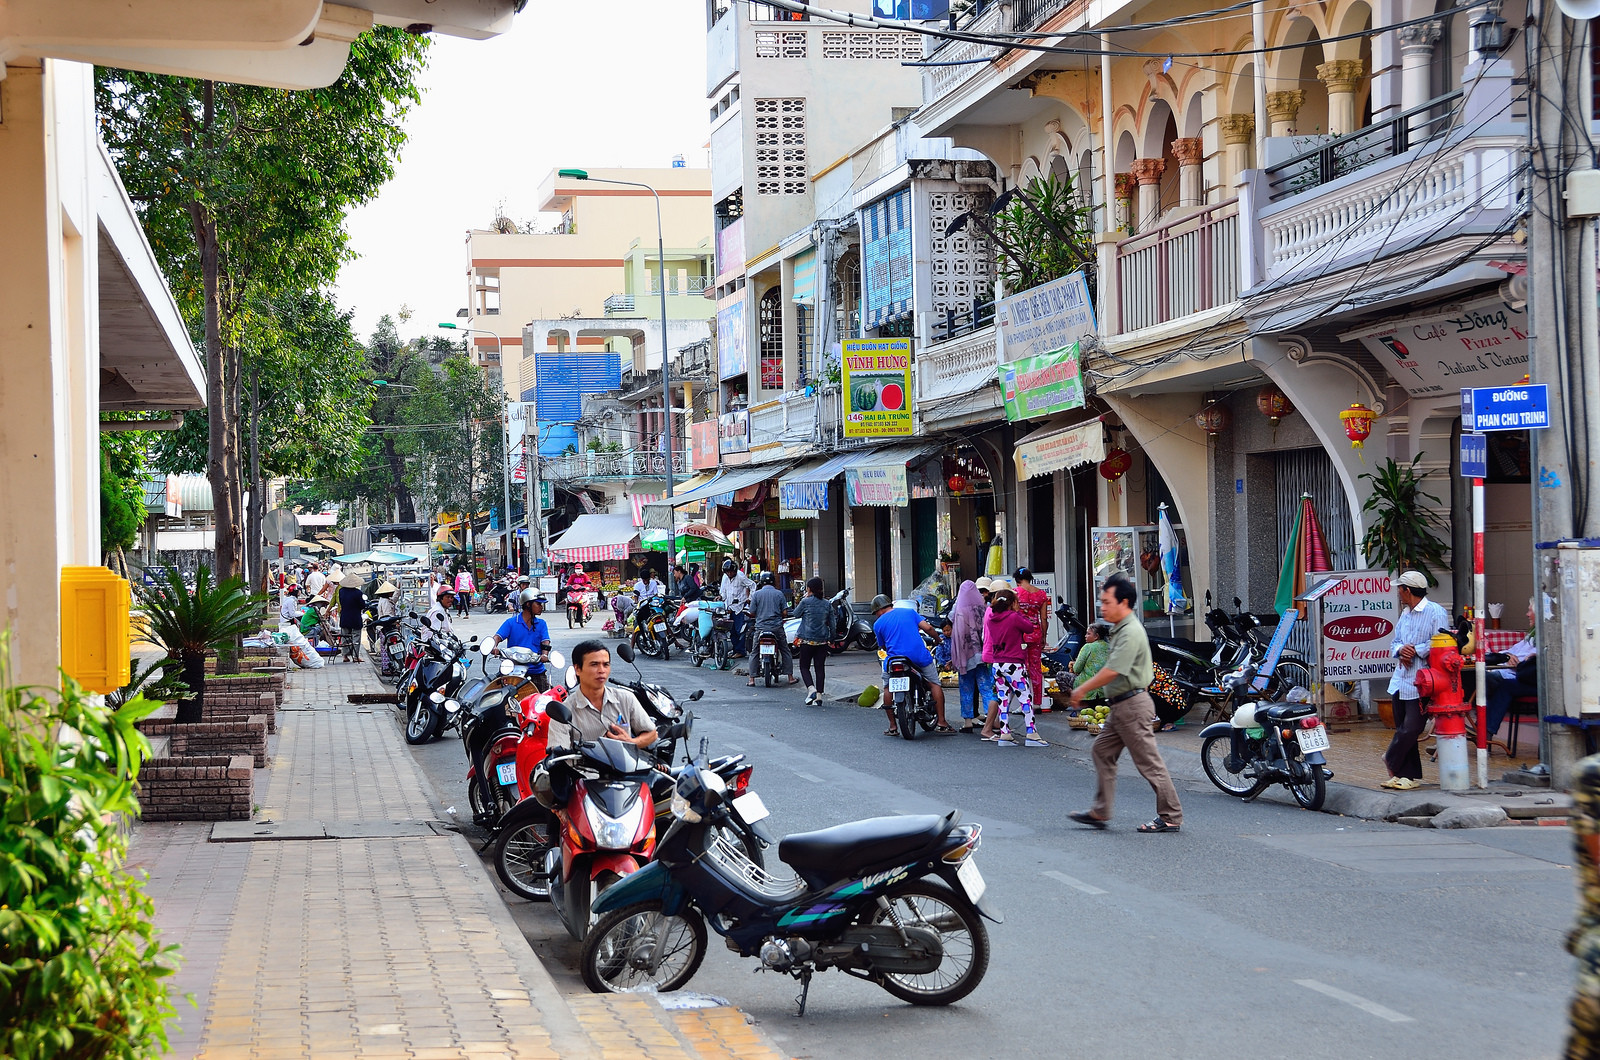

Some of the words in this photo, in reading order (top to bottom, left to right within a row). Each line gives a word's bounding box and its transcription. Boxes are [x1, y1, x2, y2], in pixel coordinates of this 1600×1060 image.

[1413, 325, 1447, 342] Café
[846, 342, 860, 352] HIỆU
[861, 341, 877, 351] BUÔN
[877, 343, 889, 352] HẠT
[890, 340, 908, 350] GIỐNG
[1460, 335, 1502, 351] Pizza
[846, 354, 874, 370] VĨNH
[876, 353, 908, 370] HƯNG
[1395, 359, 1419, 370] Pizza
[1437, 360, 1479, 377] Italian
[1479, 356, 1489, 371] &
[1492, 389, 1528, 402] ĐƯỜNG
[848, 413, 863, 421] 146
[877, 412, 887, 421] BÀ
[888, 412, 910, 420] TRƯNG
[1477, 414, 1500, 427] PHAN
[1501, 412, 1519, 426] CHU
[1519, 410, 1546, 425] TRINH
[1031, 578, 1049, 587] Hàng
[1323, 576, 1391, 598] APPUCCINO
[1323, 601, 1351, 613] Pizza
[1361, 599, 1393, 611] Pasta
[1329, 623, 1352, 638] Đặc
[1353, 621, 1371, 635] sản
[1374, 619, 1388, 636] Ý
[1326, 647, 1348, 662] Ice
[1351, 645, 1390, 661] Cream
[1323, 666, 1352, 676] BURGER
[503, 774, 516, 783] 06
[862, 864, 909, 890] Wave
[886, 871, 909, 886] 110
